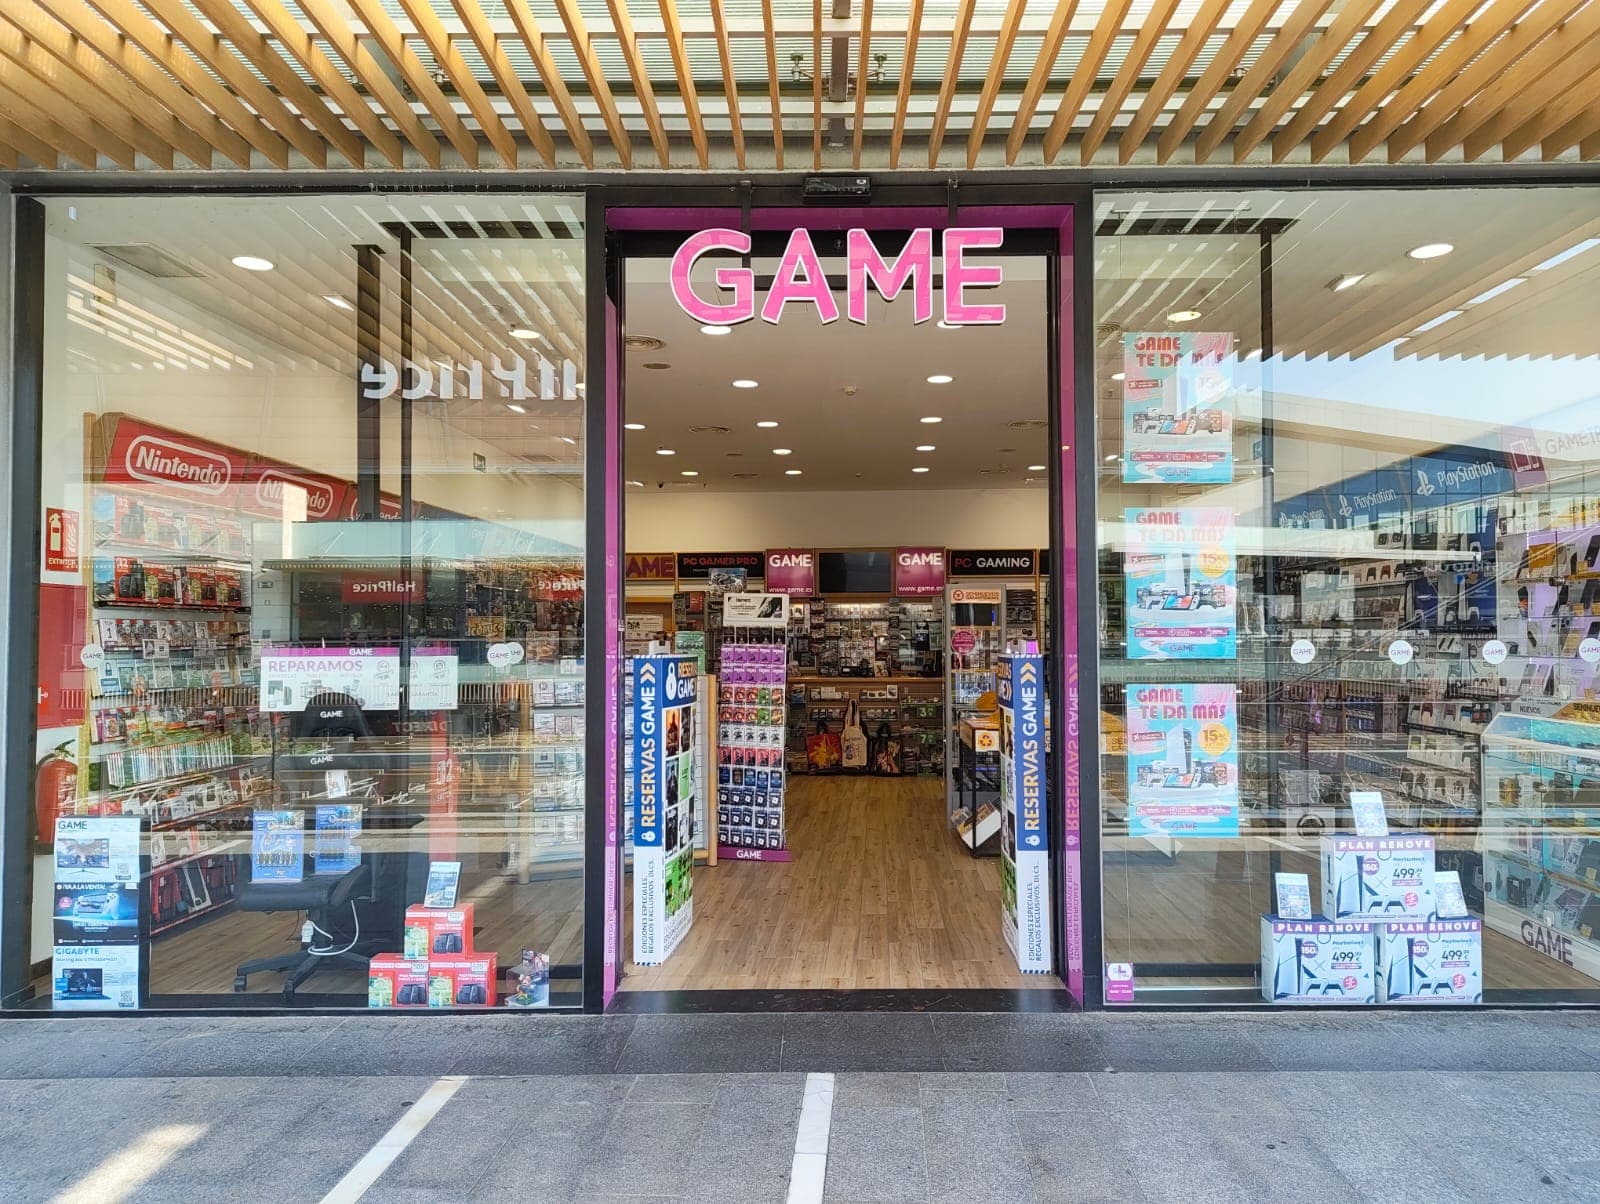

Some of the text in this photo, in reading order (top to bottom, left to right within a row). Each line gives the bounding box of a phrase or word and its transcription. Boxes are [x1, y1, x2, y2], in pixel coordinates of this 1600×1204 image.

[670, 227, 1006, 325] GAME
[1134, 336, 1181, 350] GAME
[1136, 353, 1155, 367] TE
[135, 446, 224, 487] Nintendo
[1437, 460, 1497, 489] PlayStation
[263, 479, 326, 509] Nido
[1353, 489, 1397, 512] PlayStation
[1136, 512, 1182, 525] GAME
[683, 556, 758, 565] PC GAMER PRO
[769, 554, 812, 567] GAME
[899, 552, 942, 567] GAME
[955, 557, 1030, 568] PC GAMING
[626, 556, 674, 578] AME
[1170, 643, 1195, 652] GAME
[1293, 648, 1313, 656] GAME
[1485, 648, 1505, 656] GAME
[268, 660, 363, 673] REPARAMOS
[1136, 688, 1183, 702] GAME
[1140, 702, 1226, 719] TE DA MÁS
[1573, 703, 1600, 713] SEMINUE
[310, 755, 333, 766] GAME
[641, 686, 656, 827] RESERVAS GAME
[1022, 687, 1040, 831] RESERVAS GAME
[58, 821, 87, 829] GAME
[1340, 839, 1431, 849] PLAN RENOVE
[736, 850, 762, 859] GAME
[1277, 923, 1370, 932] PLAN RENOVE
[1391, 922, 1478, 932] PLAN RENOVE
[1520, 920, 1574, 968] GAME
